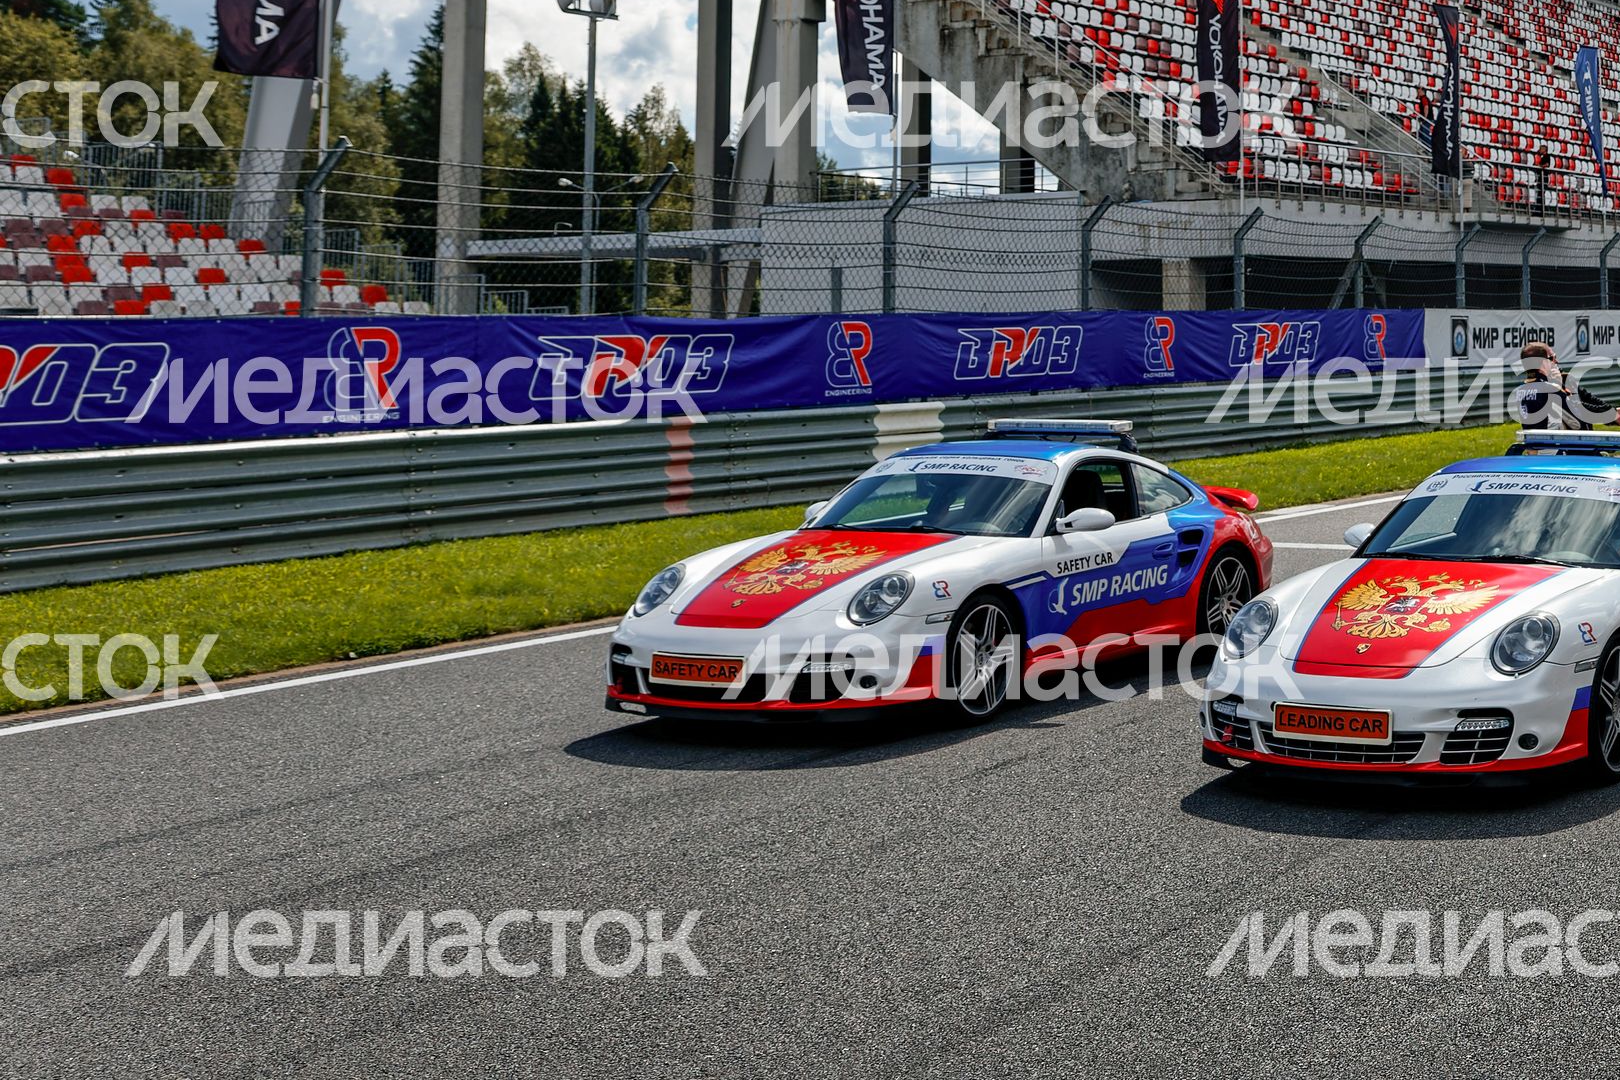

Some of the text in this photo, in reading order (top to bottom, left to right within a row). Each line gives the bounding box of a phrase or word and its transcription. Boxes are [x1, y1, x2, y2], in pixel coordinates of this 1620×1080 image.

[1208, 14, 1228, 144] YOKOHAMA
[1472, 322, 1555, 349] МИР СЕЙФОВ
[1593, 325, 1615, 345] МИР
[824, 388, 873, 397] ENGINEERING
[921, 462, 998, 473] SMP RACING
[1485, 482, 1578, 494] SMP RACING
[1057, 551, 1113, 575] SAFETY CAR
[1070, 564, 1168, 607] SMP RACING
[655, 661, 739, 679] SAFETY CAR
[1279, 709, 1384, 733] LEADING CAR
